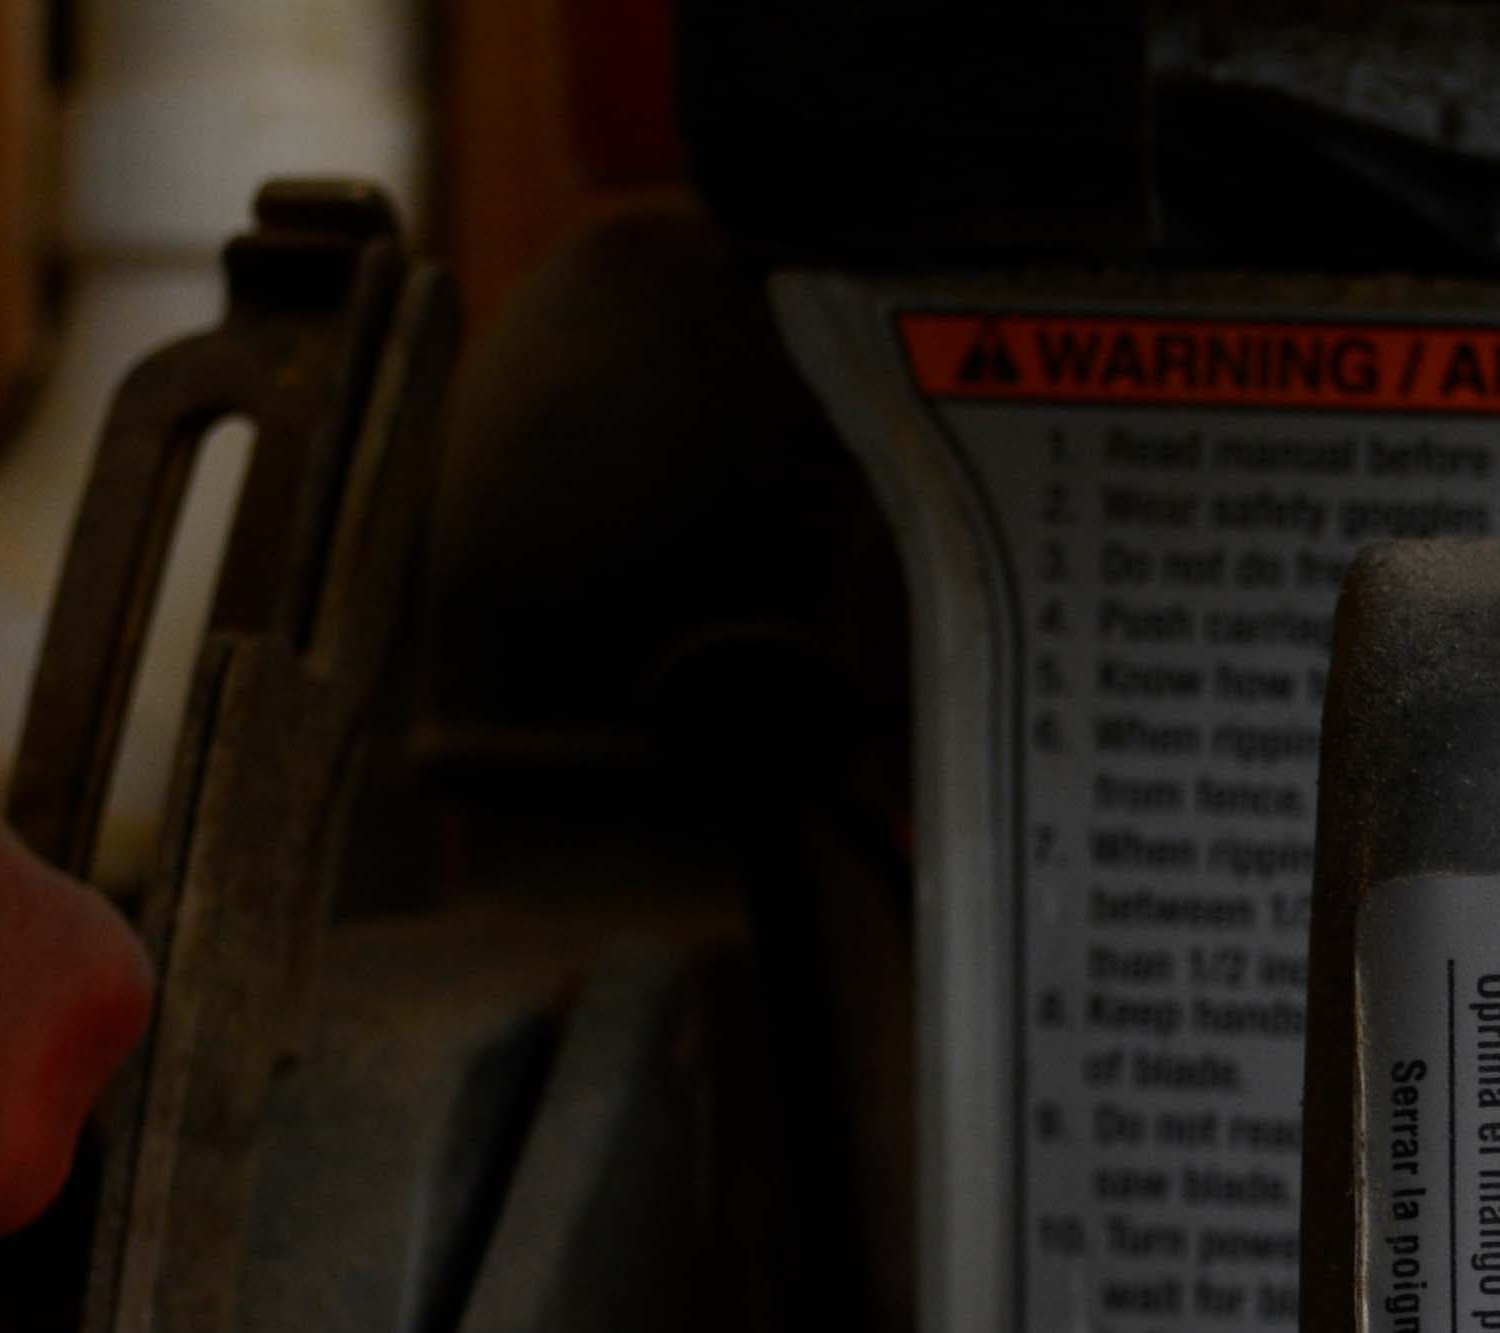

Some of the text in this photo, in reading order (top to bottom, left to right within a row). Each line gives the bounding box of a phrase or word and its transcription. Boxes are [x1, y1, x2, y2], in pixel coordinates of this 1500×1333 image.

[1039, 330, 1380, 396] WARNING
[1106, 426, 1200, 467] Read
[1213, 434, 1353, 473] manual
[1364, 435, 1490, 477] before
[1102, 484, 1200, 527] Wear
[1209, 487, 1324, 537] safety
[1338, 498, 1490, 538] goggles
[1161, 545, 1225, 588] not
[1214, 659, 1293, 699] how
[1390, 1059, 1427, 1175] Serrar
[1392, 1187, 1427, 1221] la
